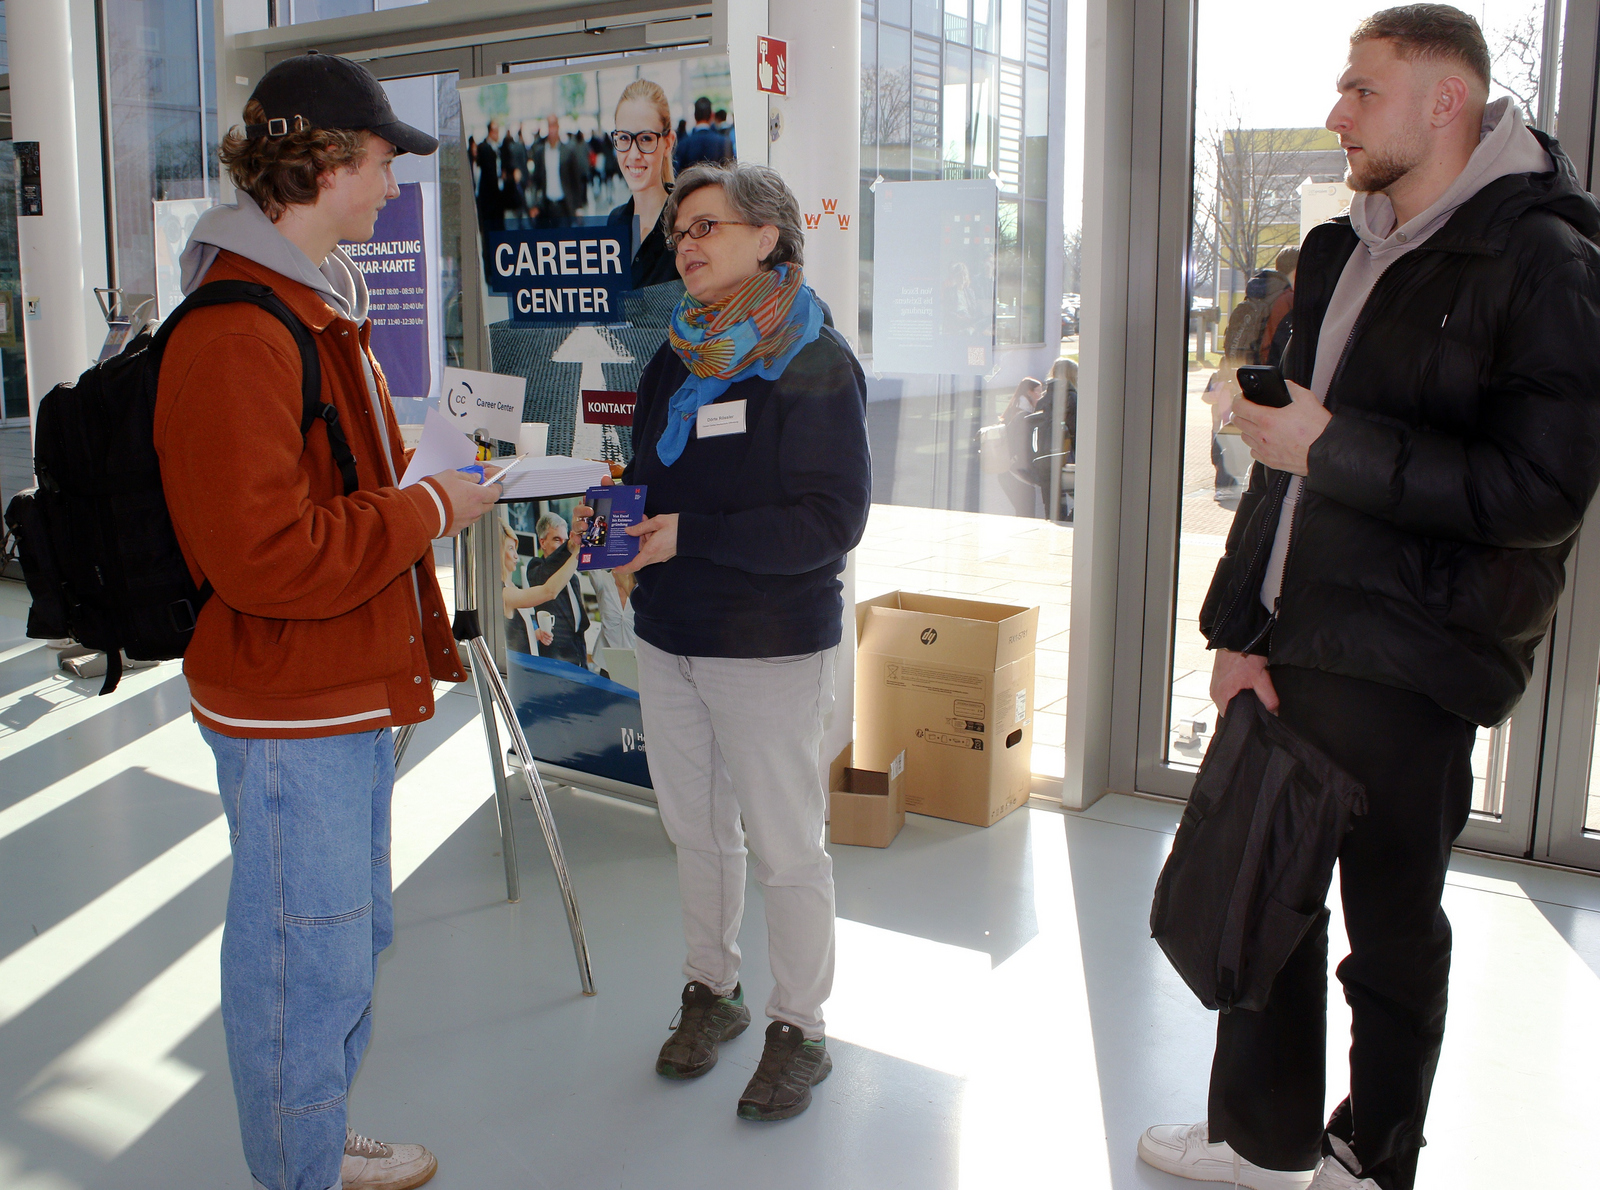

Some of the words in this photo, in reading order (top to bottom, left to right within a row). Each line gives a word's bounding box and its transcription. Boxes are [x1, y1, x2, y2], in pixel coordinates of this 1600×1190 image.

[495, 239, 622, 277] CAREER
[415, 287, 424, 295] Uhr
[516, 287, 609, 313] CENTER
[415, 302, 424, 310] Uhr
[415, 317, 424, 325] Uhr
[456, 395, 466, 404] CC
[476, 398, 496, 409] Career
[497, 401, 514, 412] Center
